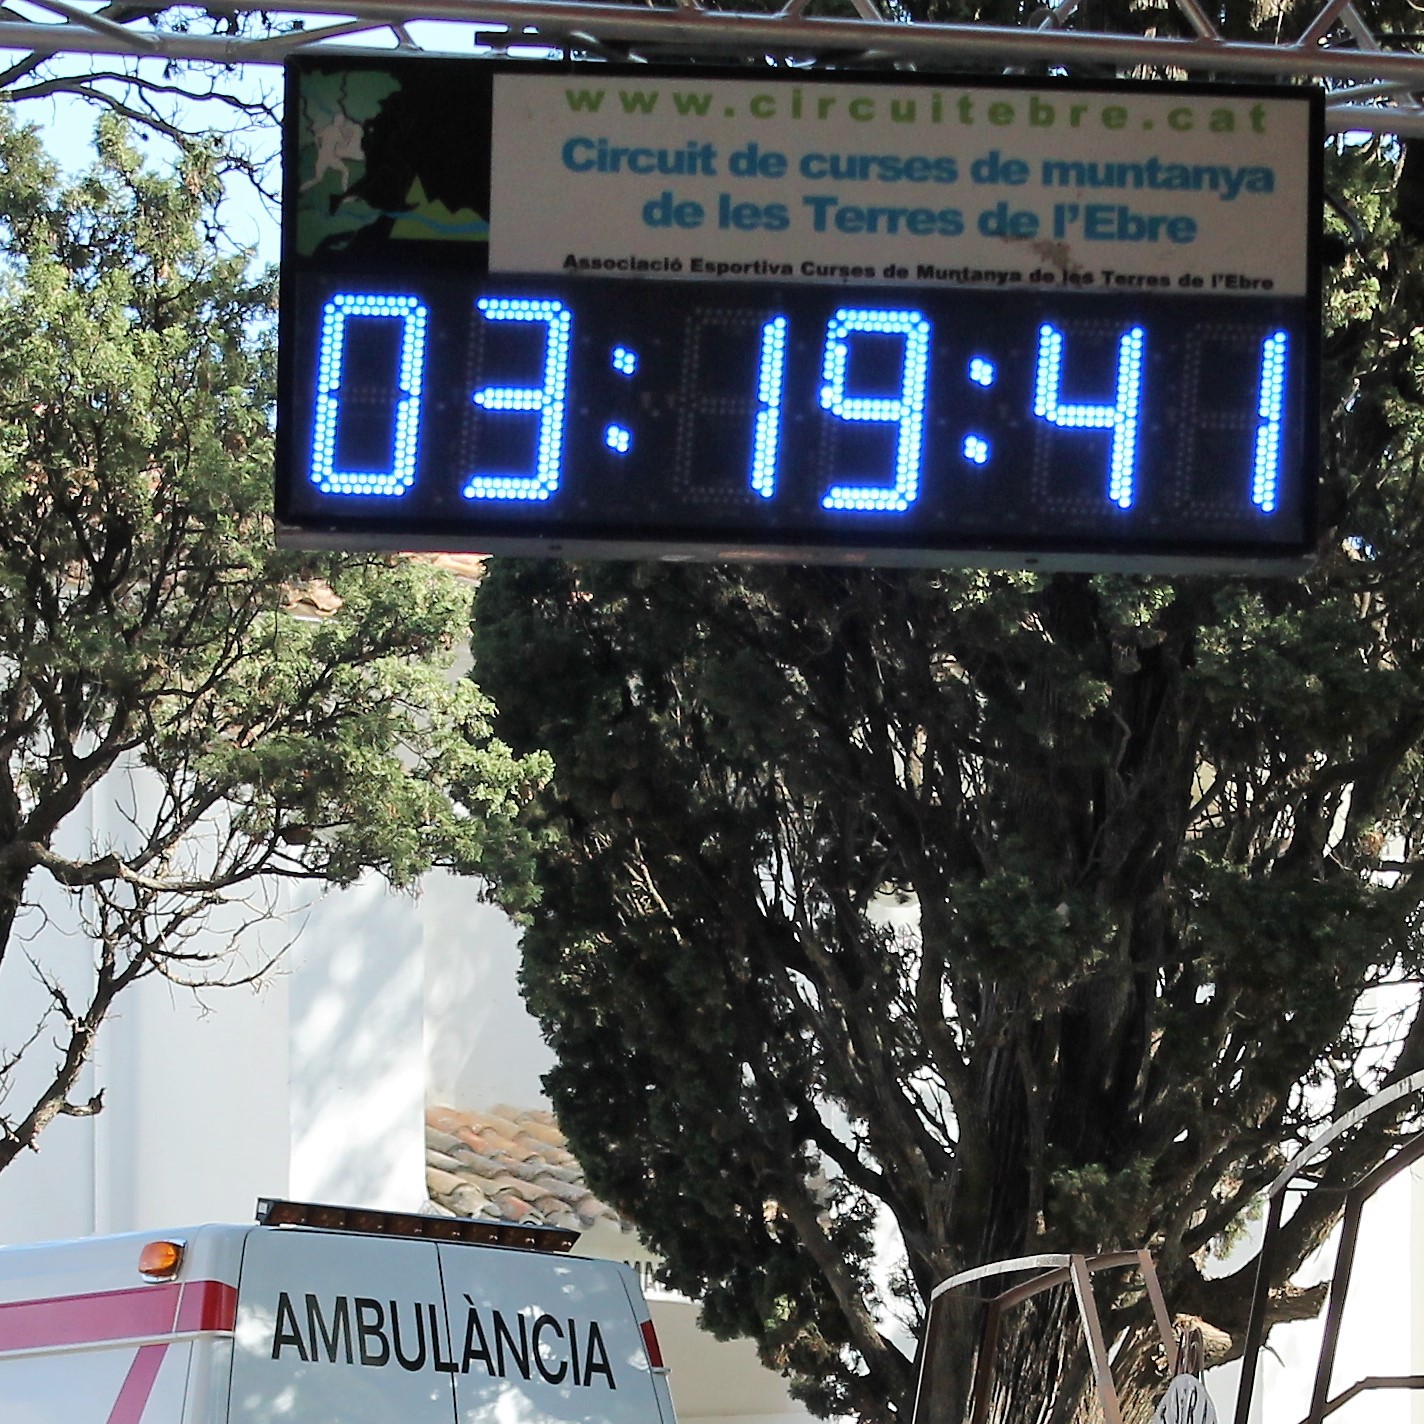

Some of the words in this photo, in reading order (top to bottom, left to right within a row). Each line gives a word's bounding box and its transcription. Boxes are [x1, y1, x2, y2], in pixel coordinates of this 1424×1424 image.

[565, 87, 1268, 134] www.circuitebre.cat
[561, 137, 717, 177] Circuit
[729, 143, 788, 179] de
[799, 151, 959, 184] curses
[970, 150, 1030, 186] de
[1041, 156, 1274, 201] muntanya
[641, 191, 705, 229] de
[718, 193, 791, 232] les
[802, 195, 965, 237] Terres
[978, 202, 1040, 239] de
[1053, 204, 1198, 244] l'Ebre
[563, 254, 683, 274] Associació
[690, 257, 793, 277] Esportiva
[801, 261, 876, 279] Curses
[882, 263, 909, 280] de
[917, 264, 1022, 287] Muntanya
[1028, 268, 1055, 285] de
[1102, 270, 1171, 288] Terres
[1178, 272, 1205, 289] de
[271, 1292, 617, 1390] AMBULÀNCIA
